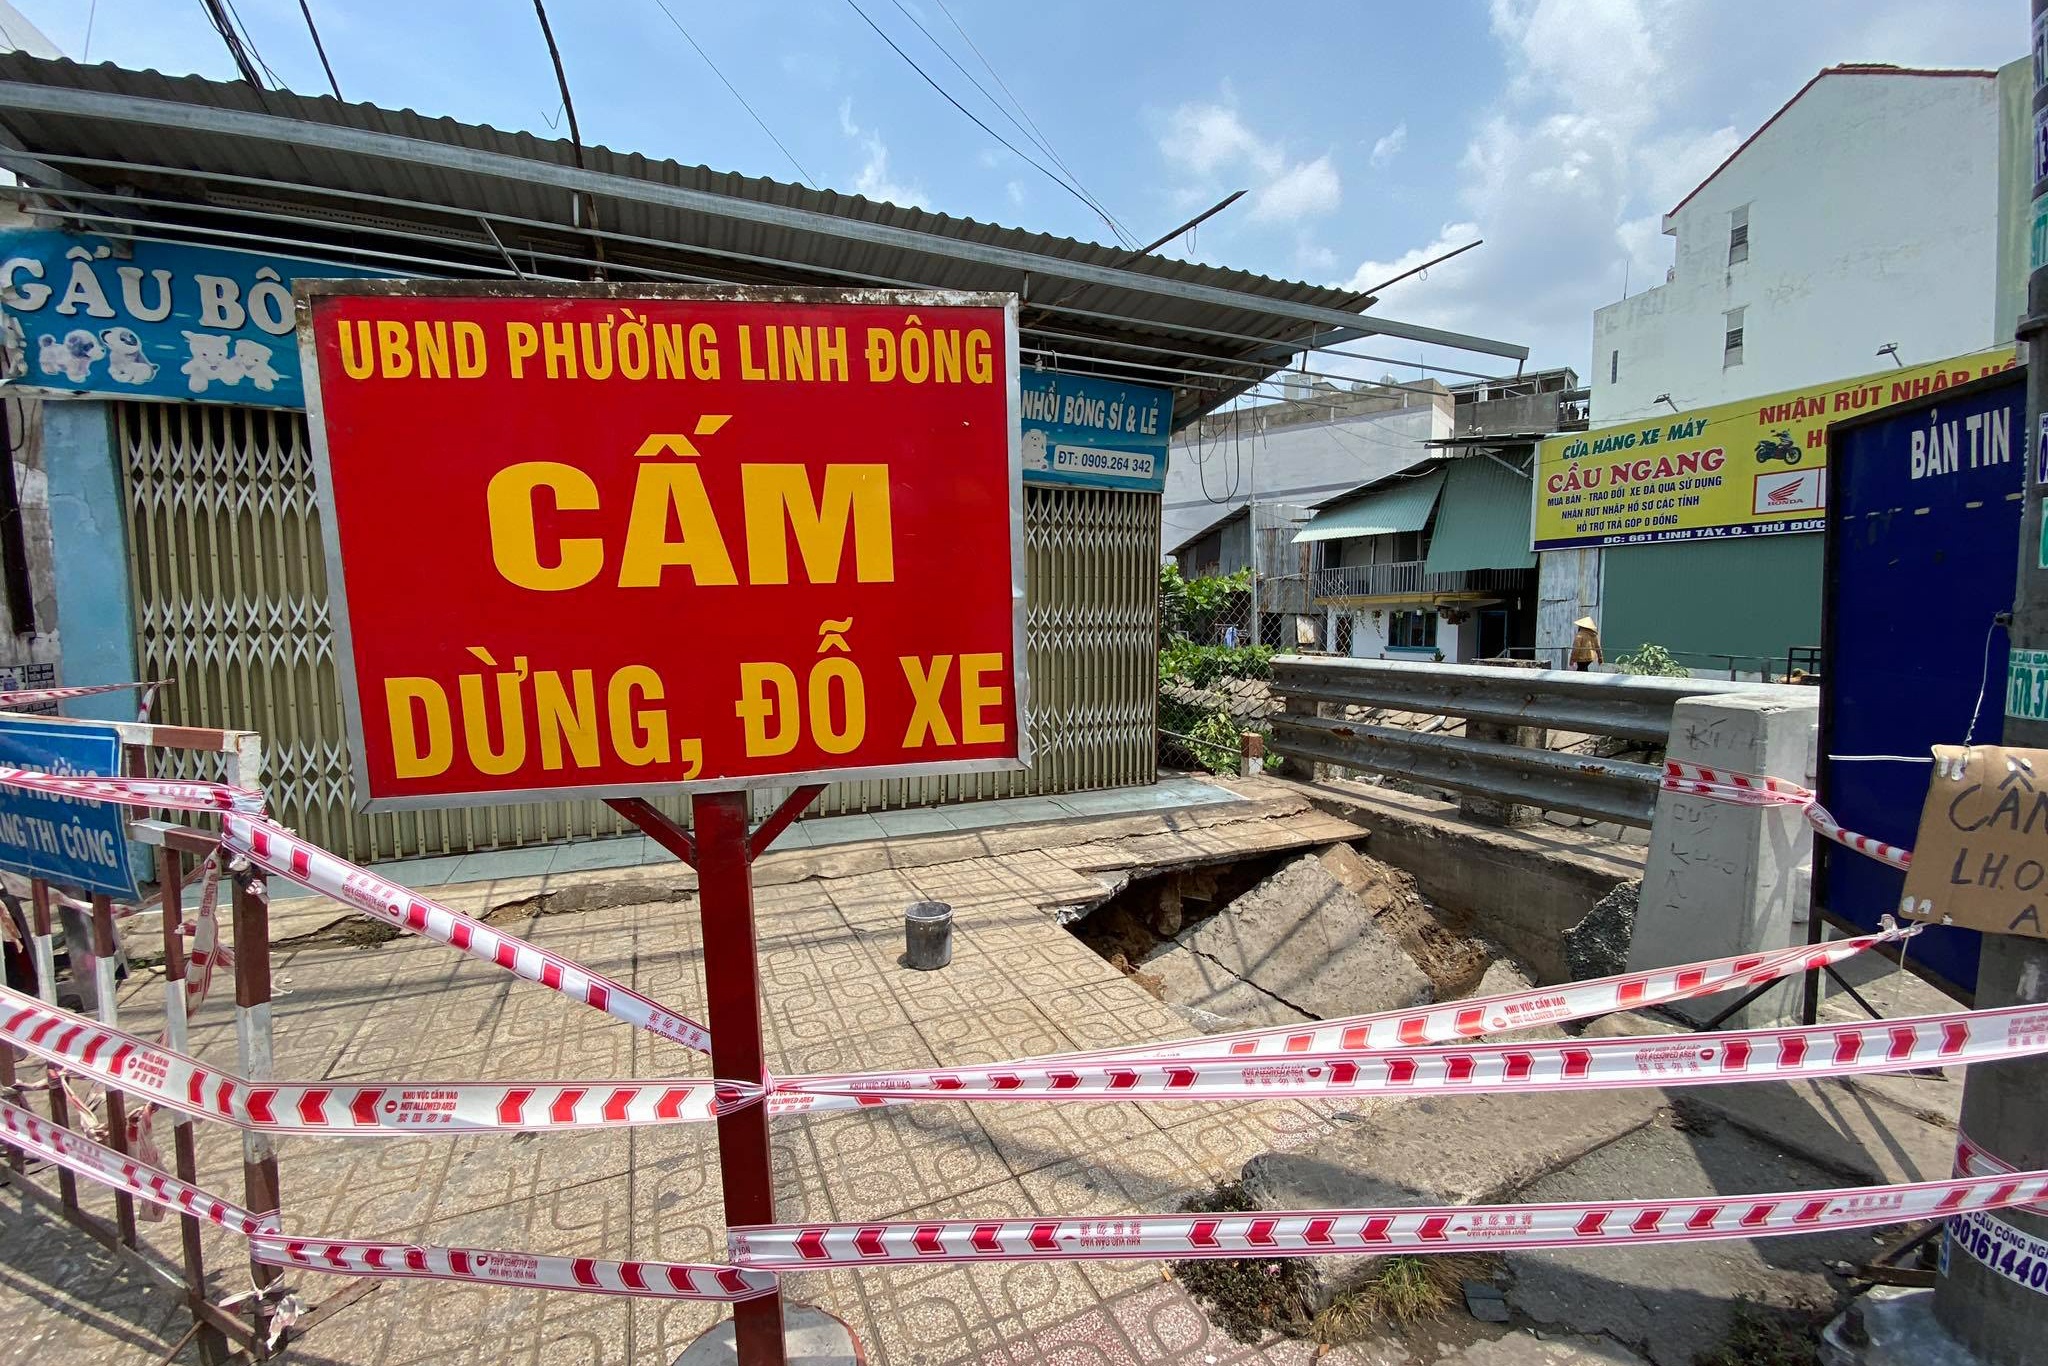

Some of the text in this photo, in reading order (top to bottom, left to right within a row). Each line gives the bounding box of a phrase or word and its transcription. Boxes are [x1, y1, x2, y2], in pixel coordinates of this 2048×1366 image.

[1, 246, 172, 321] GẤU
[338, 308, 993, 384] UBND PHƯỜNG LINH ĐÔNG
[1063, 390, 1105, 429] BÔNG
[1759, 397, 1826, 426] NHẬN
[1834, 384, 1884, 412] RÚT
[1562, 417, 1709, 460] CỬA HÀNG XE MÁY
[1911, 408, 1959, 480] BẢN
[1966, 406, 2011, 468] TIN
[1058, 451, 1151, 473] ĐT: 0909.264 342
[1547, 447, 1726, 495] CẦU NGANG
[486, 415, 894, 592] CẤM
[1547, 498, 1564, 507] MUA
[1589, 492, 1608, 501] TRAO
[1630, 485, 1641, 496] XE
[1658, 482, 1676, 494] QUA
[1695, 475, 1722, 490] DỤNG
[1657, 530, 1691, 540] LINH
[1752, 521, 1785, 533] THỦ
[384, 616, 1005, 780] DỪNG, ĐỖ XE
[26, 817, 60, 856] THI
[60, 816, 118, 868] CÔNG
[441, 1102, 457, 1110] AREA
